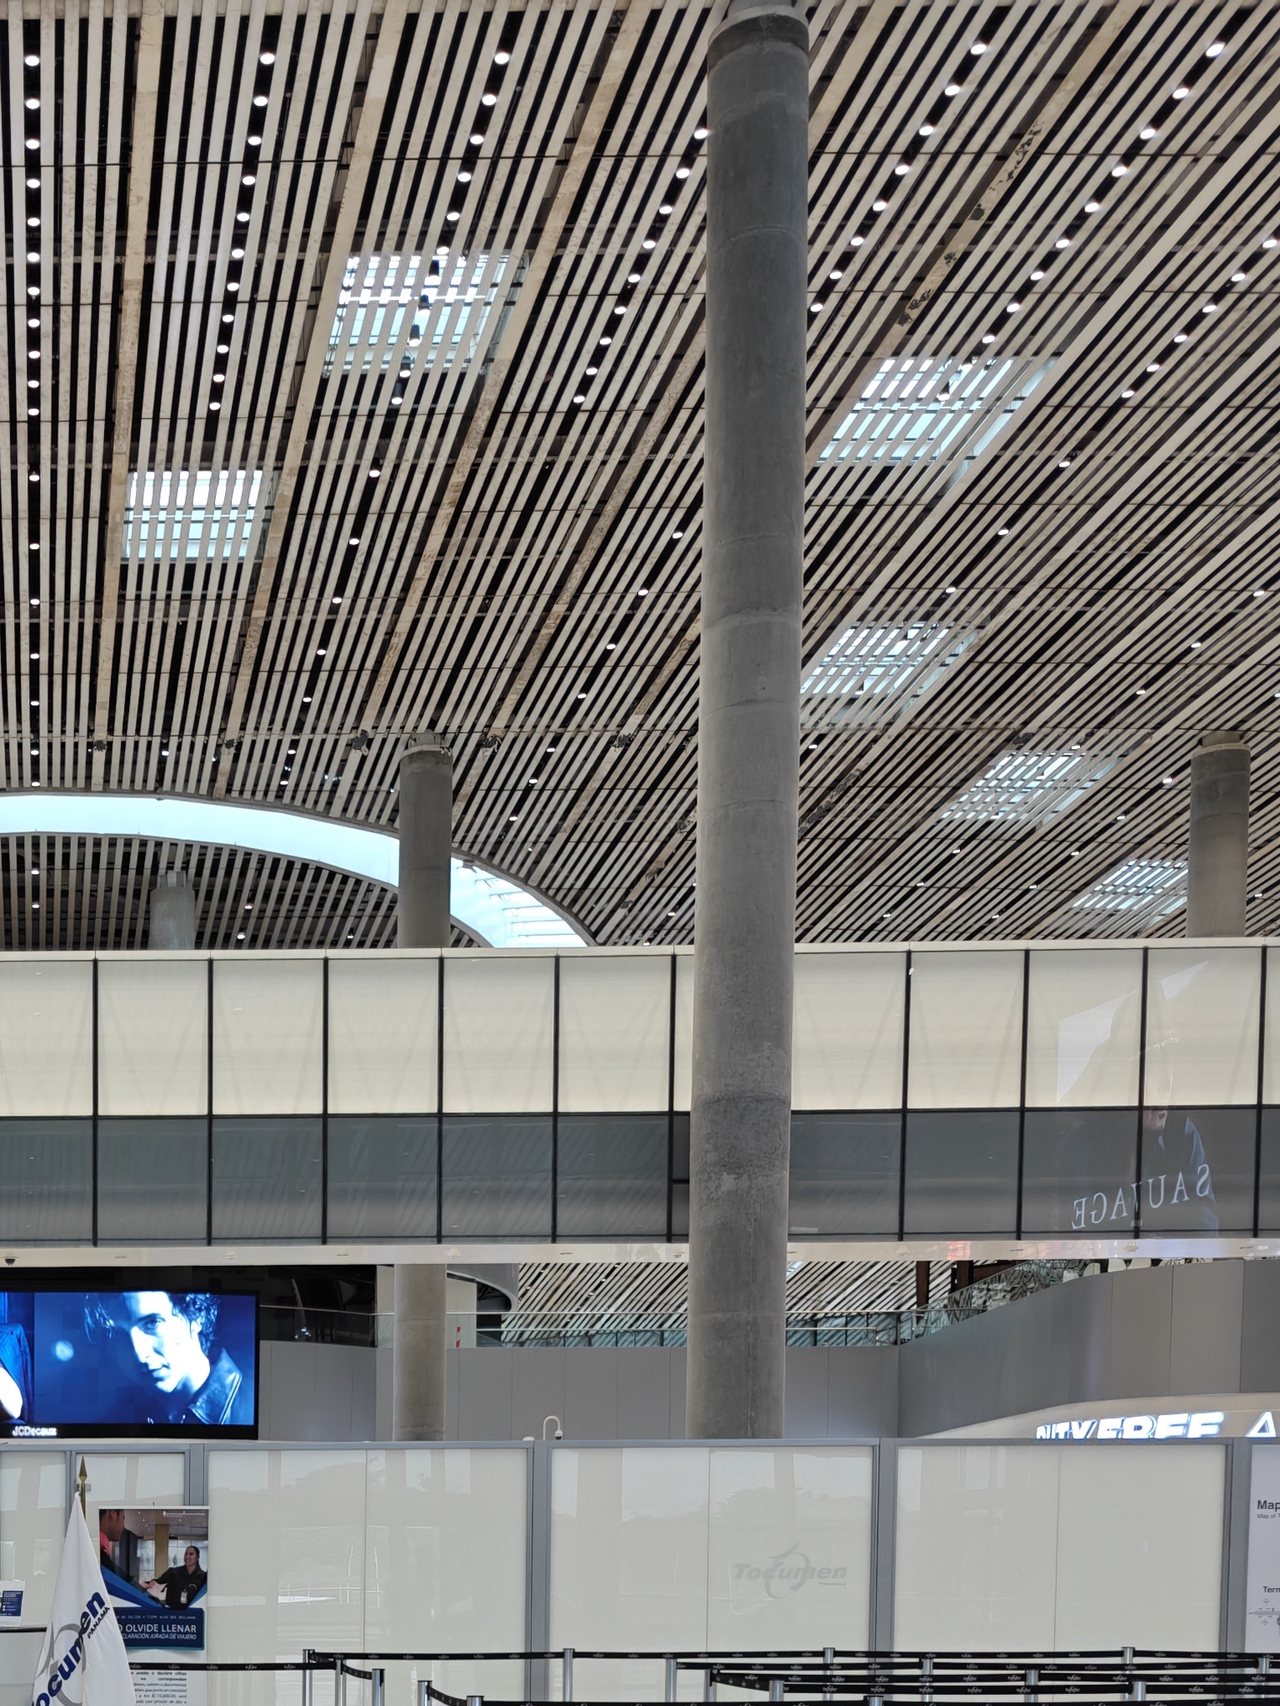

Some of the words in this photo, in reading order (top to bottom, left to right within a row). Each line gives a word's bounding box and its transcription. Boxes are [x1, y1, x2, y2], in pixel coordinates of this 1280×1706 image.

[12, 1425, 57, 1437] JCDecaux
[733, 1563, 848, 1580] Tocumen
[125, 1623, 159, 1633] OLVIDE
[161, 1624, 197, 1633] LLENAR
